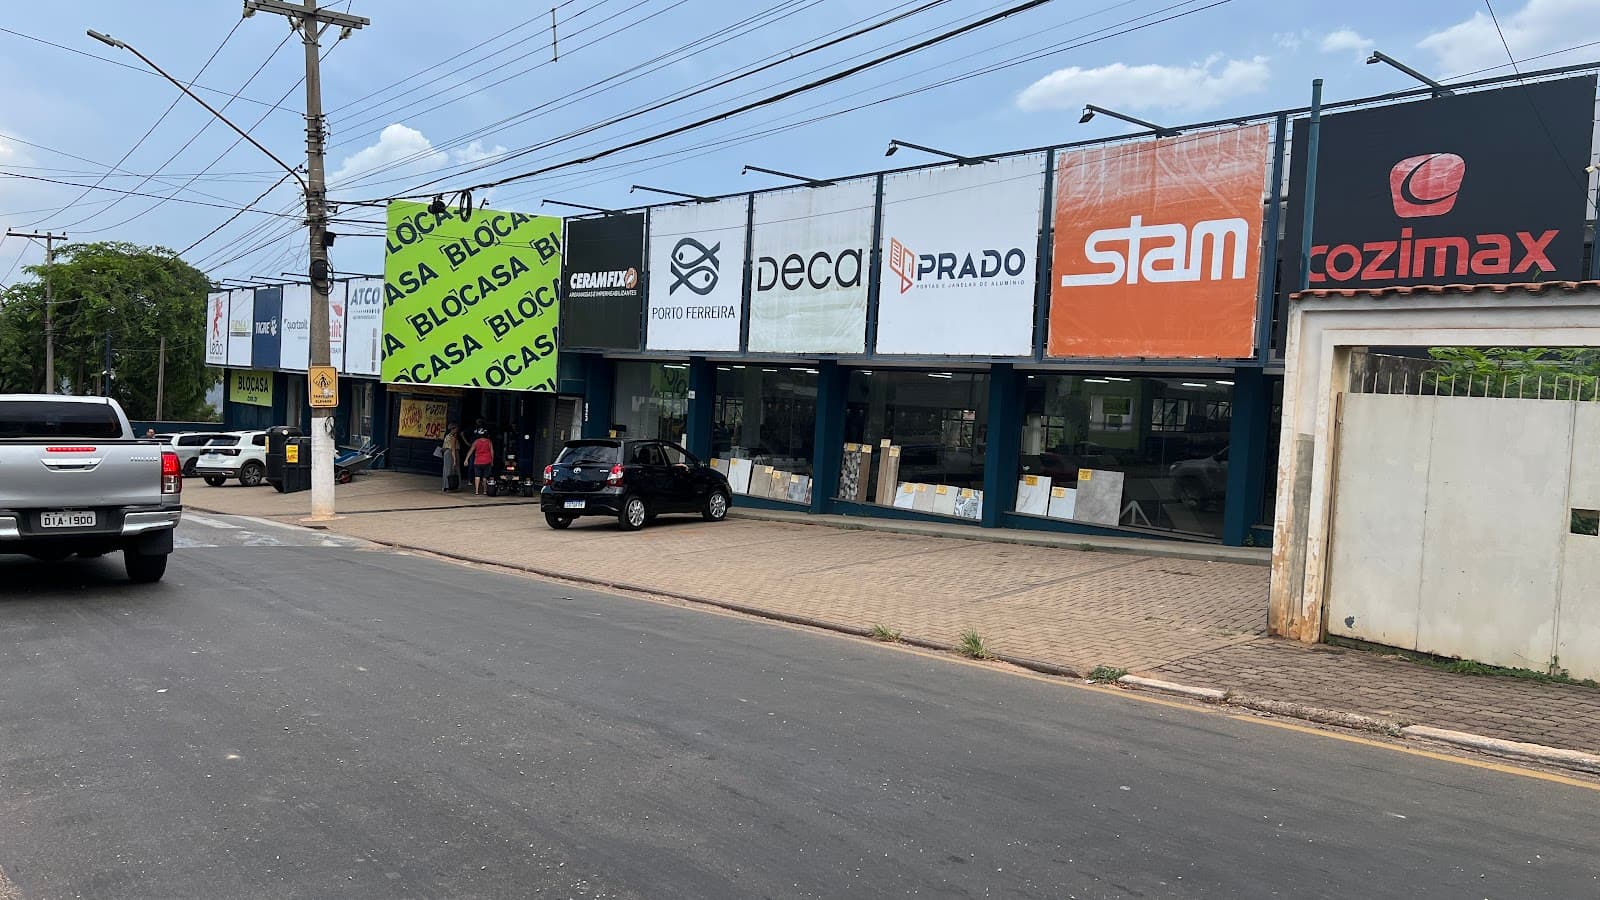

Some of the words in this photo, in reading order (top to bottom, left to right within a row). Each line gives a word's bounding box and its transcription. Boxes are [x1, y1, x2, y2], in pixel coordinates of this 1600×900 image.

[444, 212, 538, 267] BLOCA
[1061, 215, 1249, 287] stam
[917, 248, 1026, 281] PRADO
[383, 262, 439, 311] ASA
[570, 270, 628, 289] CERAMFIX
[350, 286, 380, 306] ATCO
[410, 256, 530, 338] BLOCASA
[652, 306, 683, 320] PORTO
[686, 305, 736, 320] FERREIRA
[255, 321, 270, 335] TIGRE
[238, 375, 269, 393] BLOCASA
